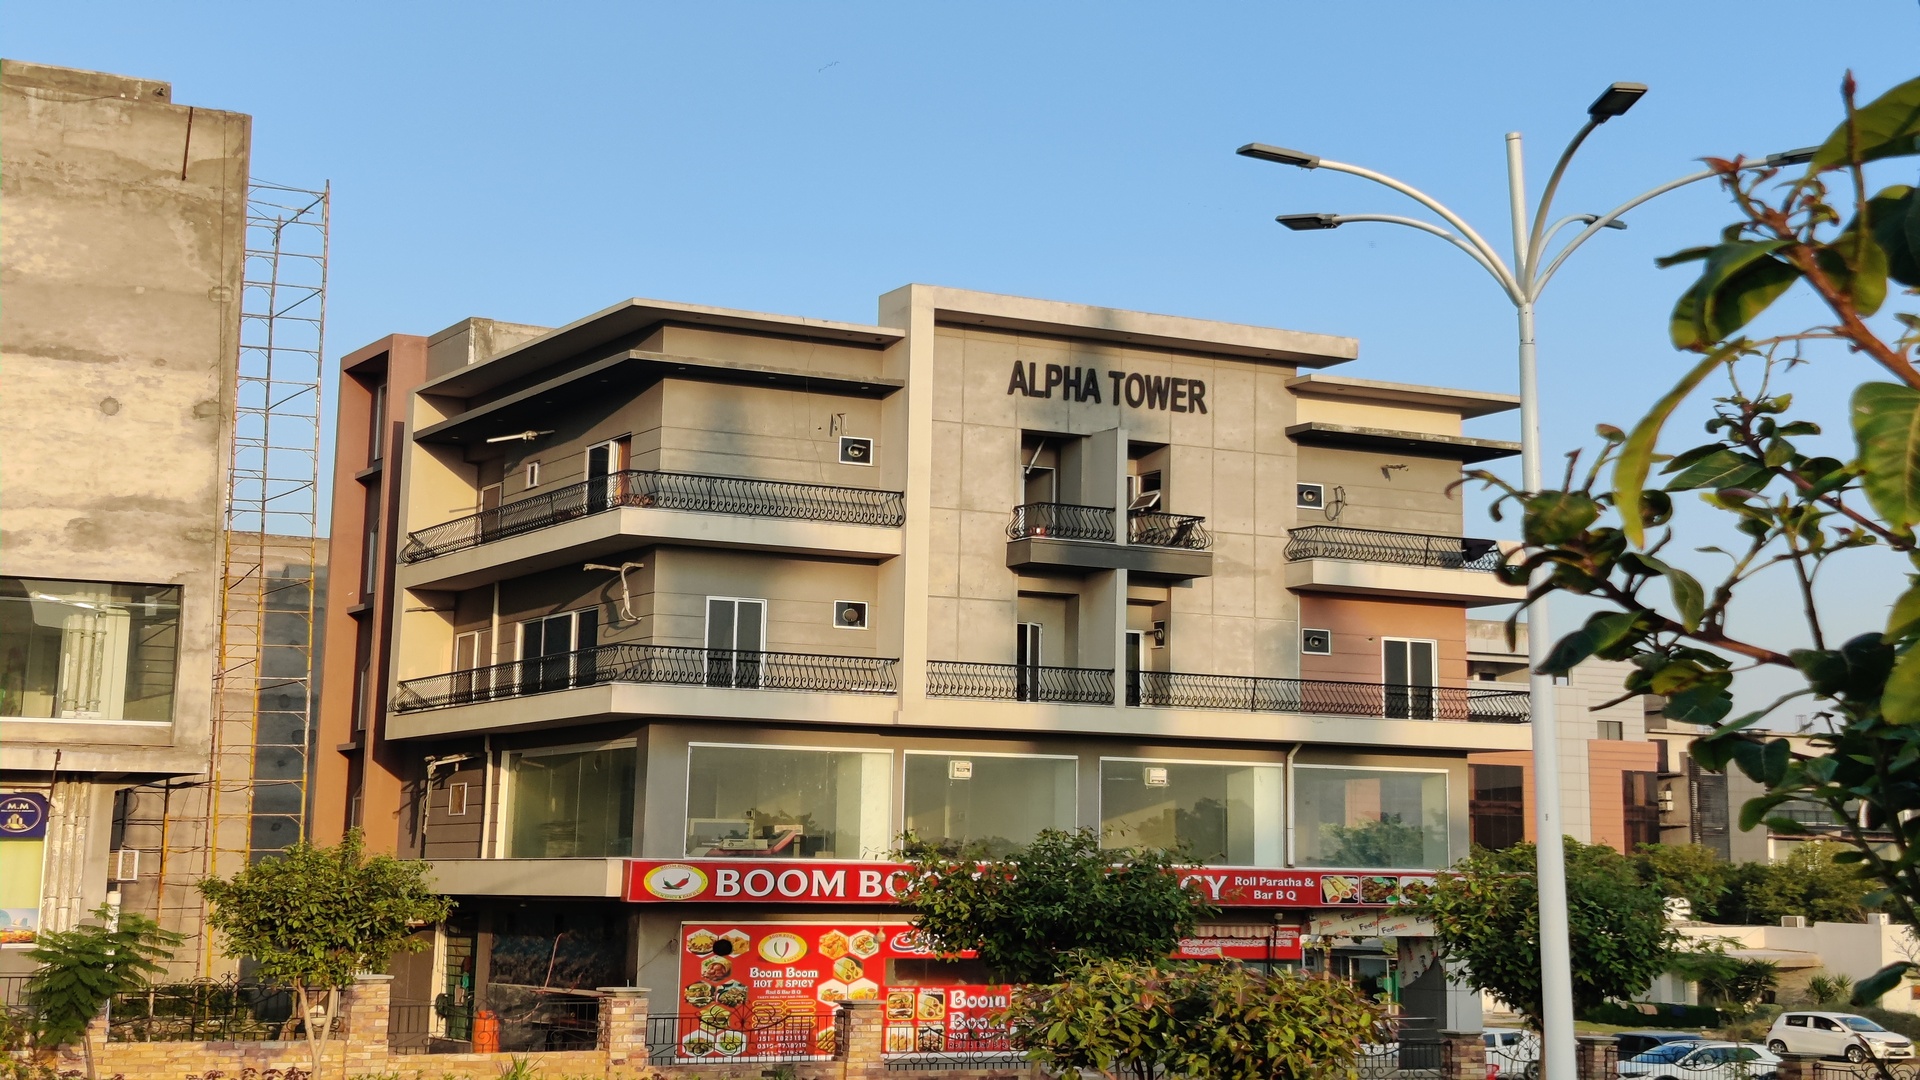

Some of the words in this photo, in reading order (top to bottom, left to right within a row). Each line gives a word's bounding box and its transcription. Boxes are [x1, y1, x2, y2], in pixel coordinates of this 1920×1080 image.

[1007, 360, 1101, 404] ALPHA
[1108, 370, 1208, 414] TOWER
[714, 868, 847, 898] BOOM
[1234, 876, 1257, 887] Roll
[1259, 876, 1302, 888] Paratha
[1303, 877, 1315, 888] &
[1253, 889, 1274, 900] Bar
[1275, 889, 1284, 900] B
[1285, 890, 1297, 901] Q
[749, 967, 783, 978] Boom
[785, 966, 819, 978] Boom
[753, 979, 773, 988] HOT
[785, 979, 815, 988] SPICY
[949, 989, 1007, 1009] Boom
